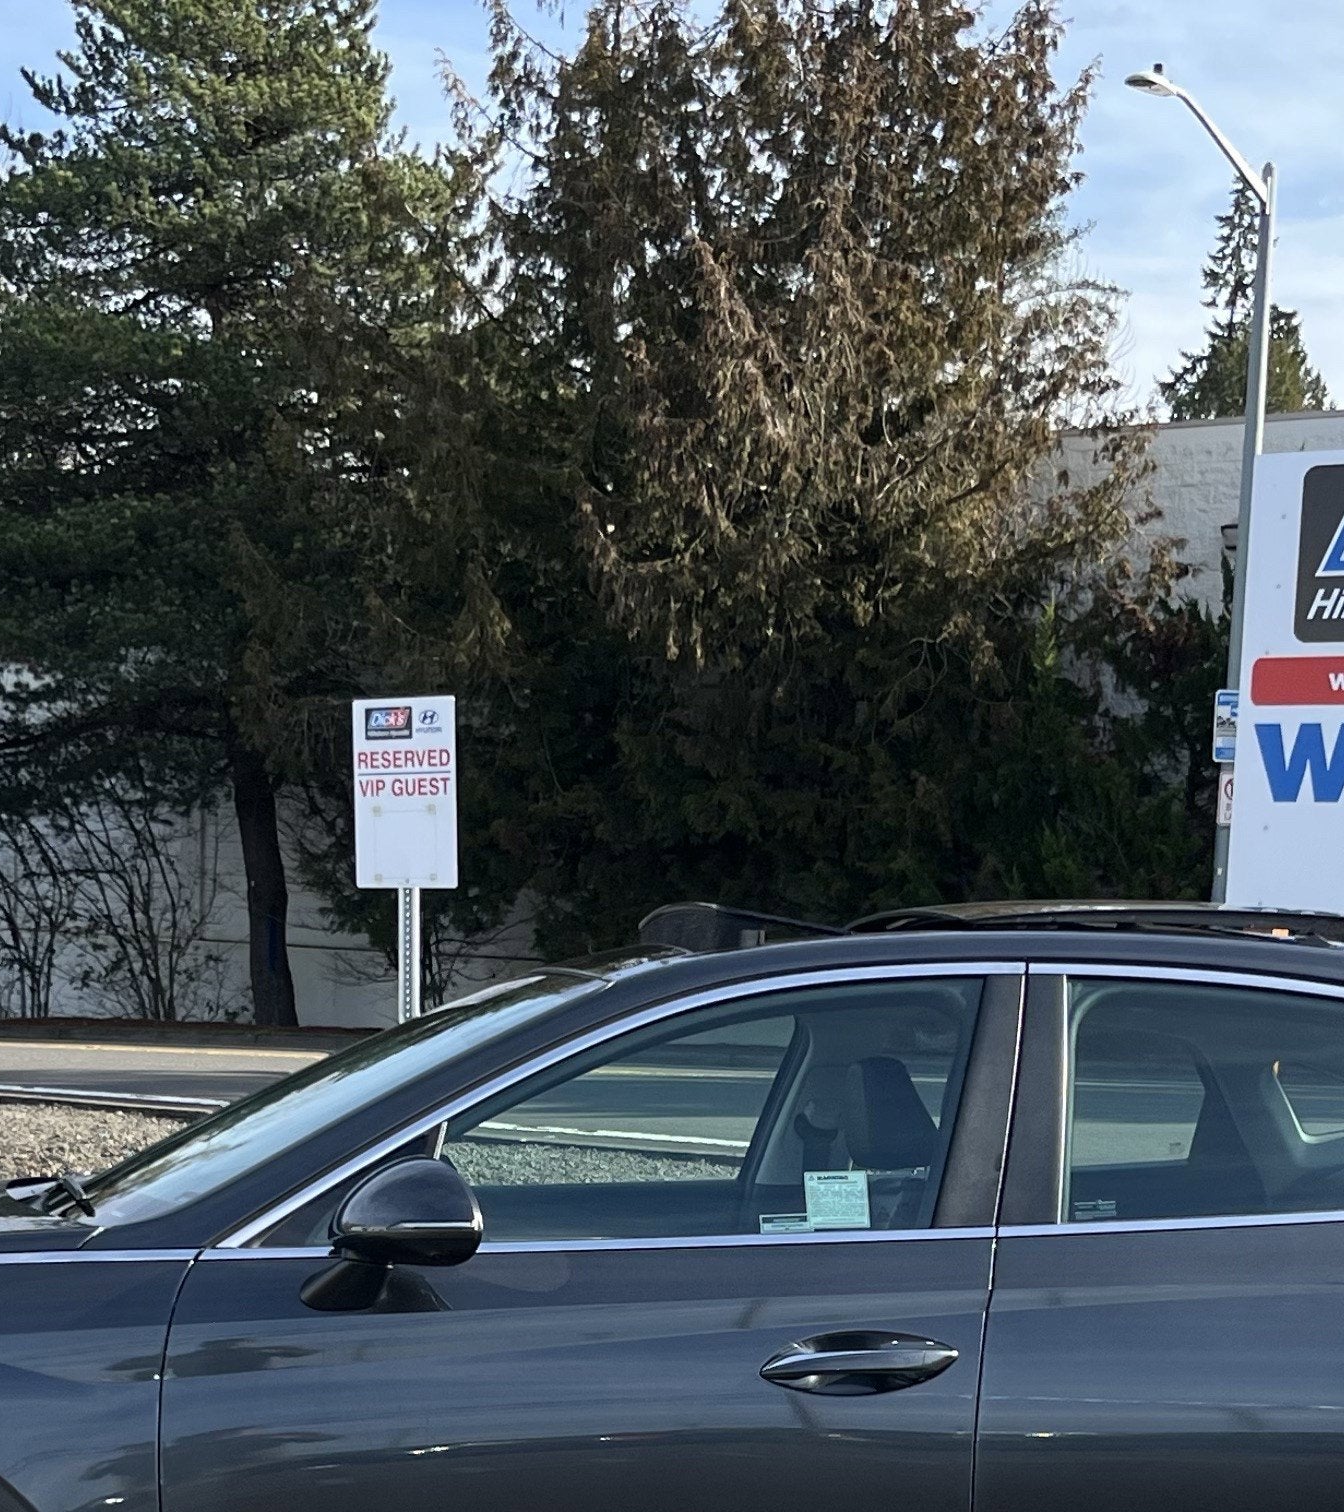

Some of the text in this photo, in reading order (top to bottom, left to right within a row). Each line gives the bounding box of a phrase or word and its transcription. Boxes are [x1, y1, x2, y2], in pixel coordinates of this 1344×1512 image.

[358, 748, 451, 770] RESERVED
[359, 777, 451, 797] VIP GUEST
